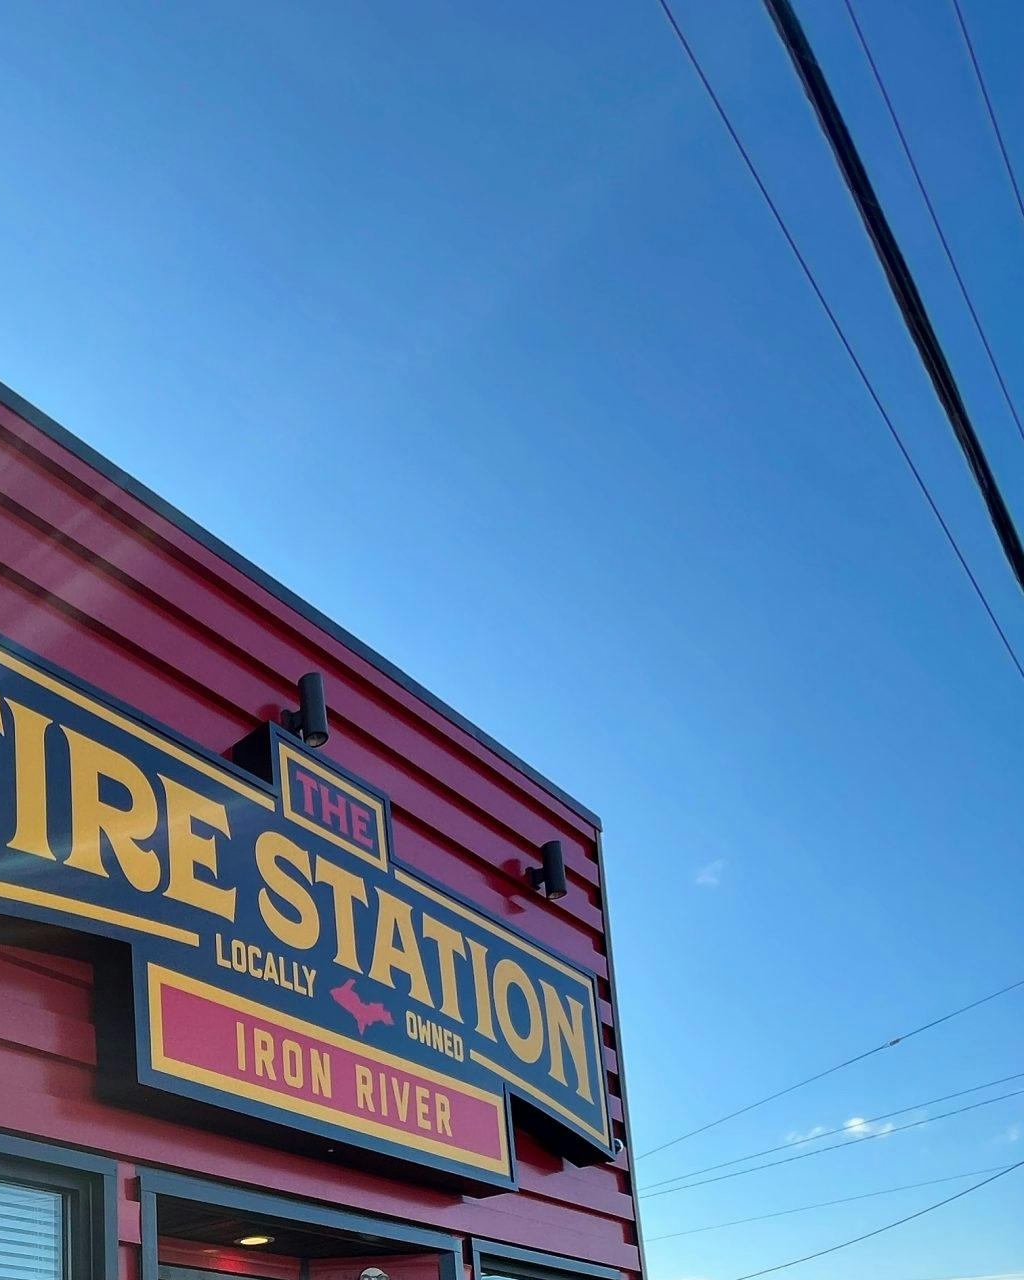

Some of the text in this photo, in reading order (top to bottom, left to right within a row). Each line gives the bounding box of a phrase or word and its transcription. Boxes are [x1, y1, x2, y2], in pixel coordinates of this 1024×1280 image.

[294, 767, 374, 849] THE
[214, 932, 464, 1063] LOCALLY OWNED
[253, 831, 595, 1105] STATION
[234, 1021, 453, 1138] IRON RIVER
